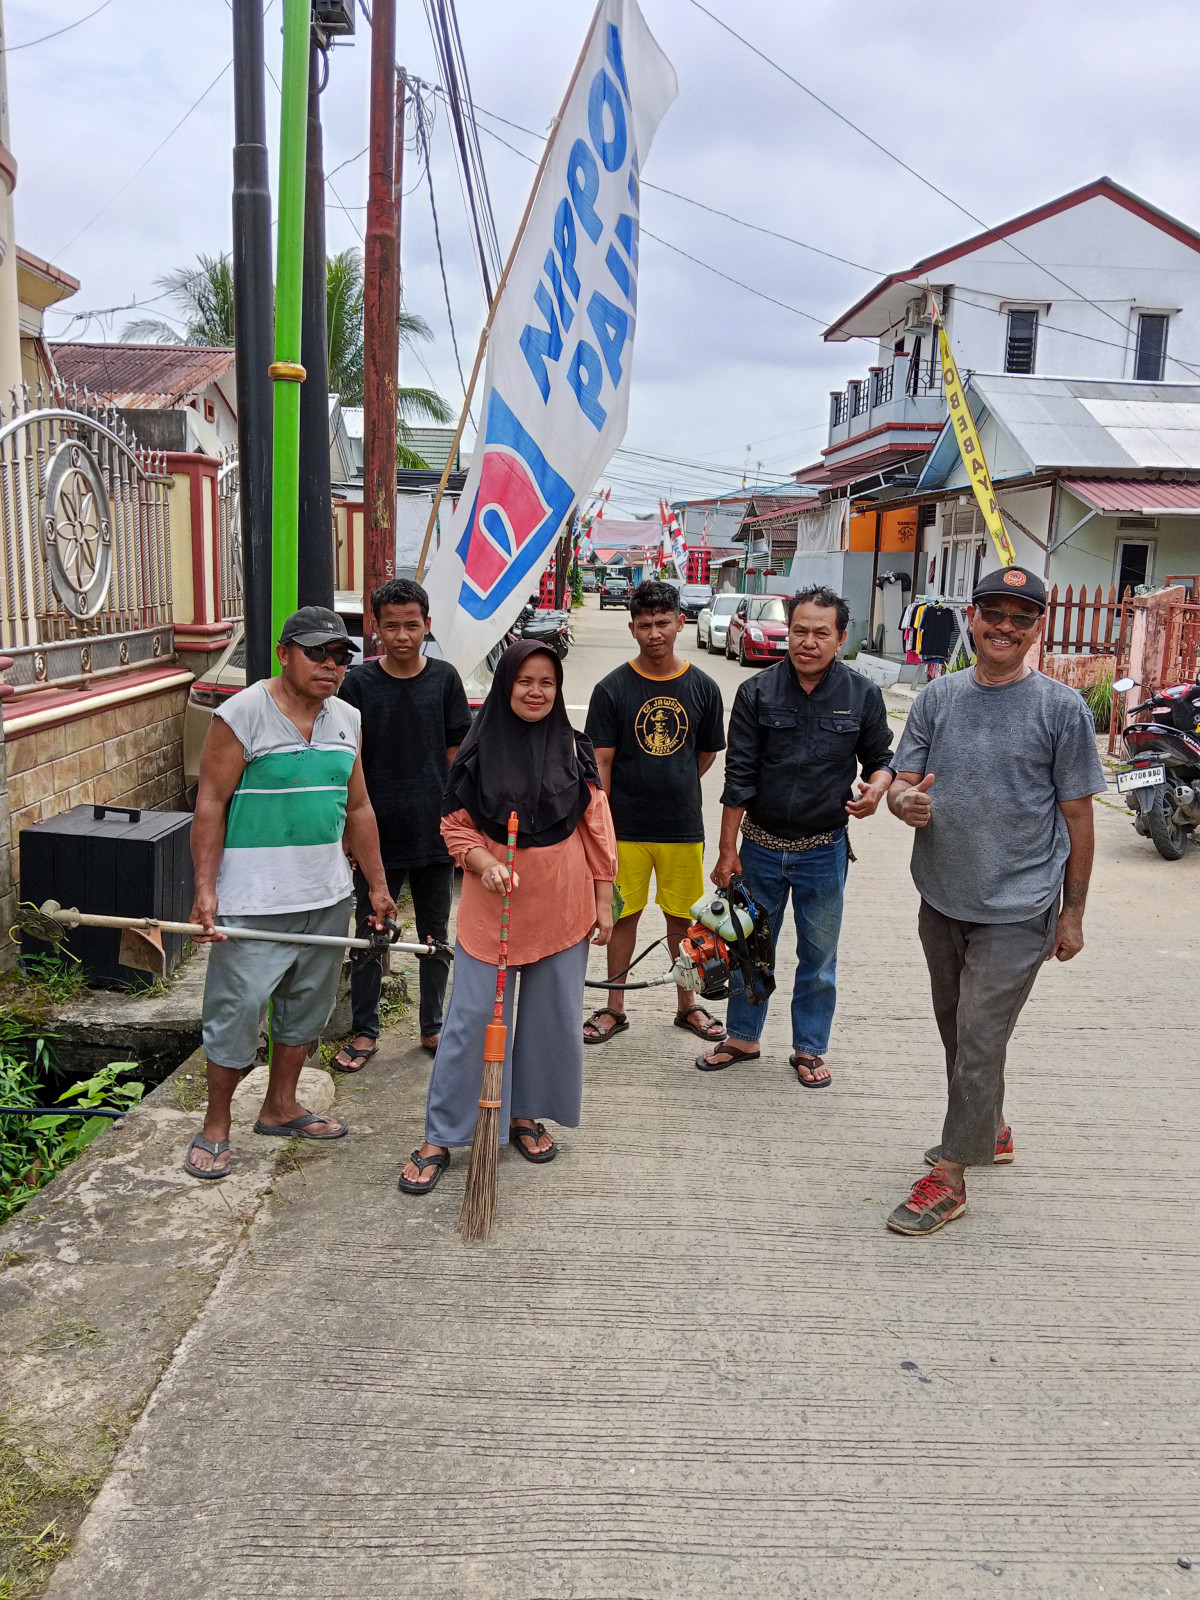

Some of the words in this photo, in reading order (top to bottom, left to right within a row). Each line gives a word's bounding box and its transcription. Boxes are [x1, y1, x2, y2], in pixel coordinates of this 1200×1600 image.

[566, 150, 640, 433] PAI
[385, 559, 394, 584] LKM
[1119, 775, 1127, 783] KT
